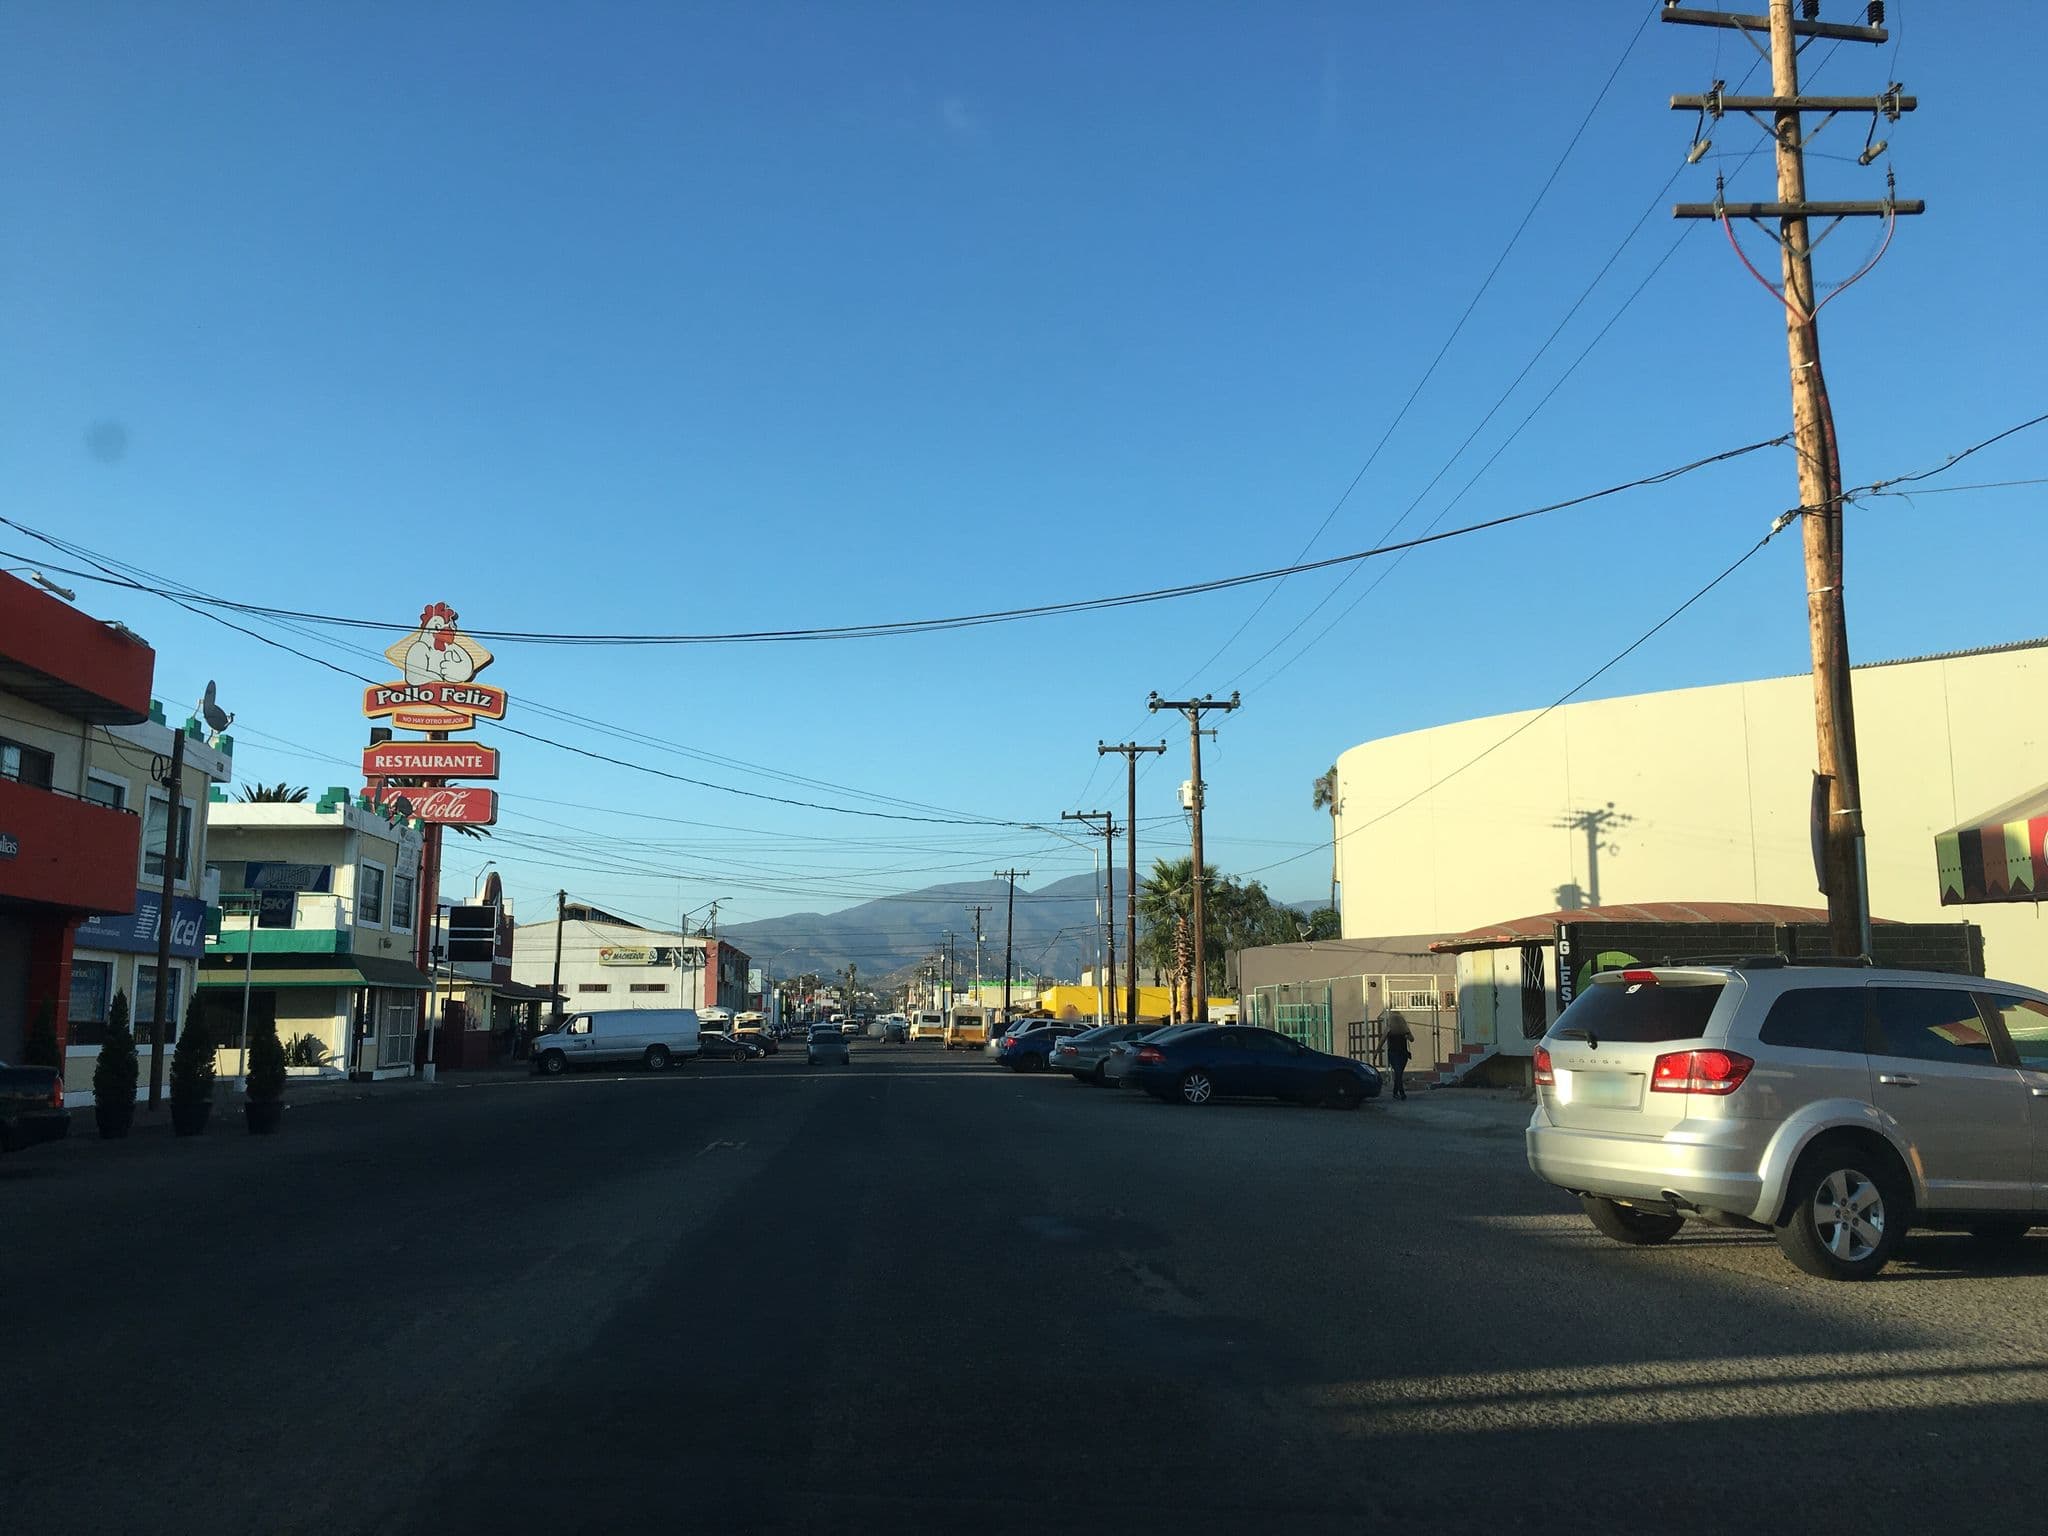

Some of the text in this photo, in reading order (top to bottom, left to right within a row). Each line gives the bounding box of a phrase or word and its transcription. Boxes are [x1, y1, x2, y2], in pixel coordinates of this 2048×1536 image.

[376, 687, 493, 707] Pollo Feliz
[374, 755, 483, 768] RESTAURANTE
[383, 791, 470, 818] Ca-Cola
[261, 896, 293, 912] SKY
[152, 910, 204, 947] tlcel
